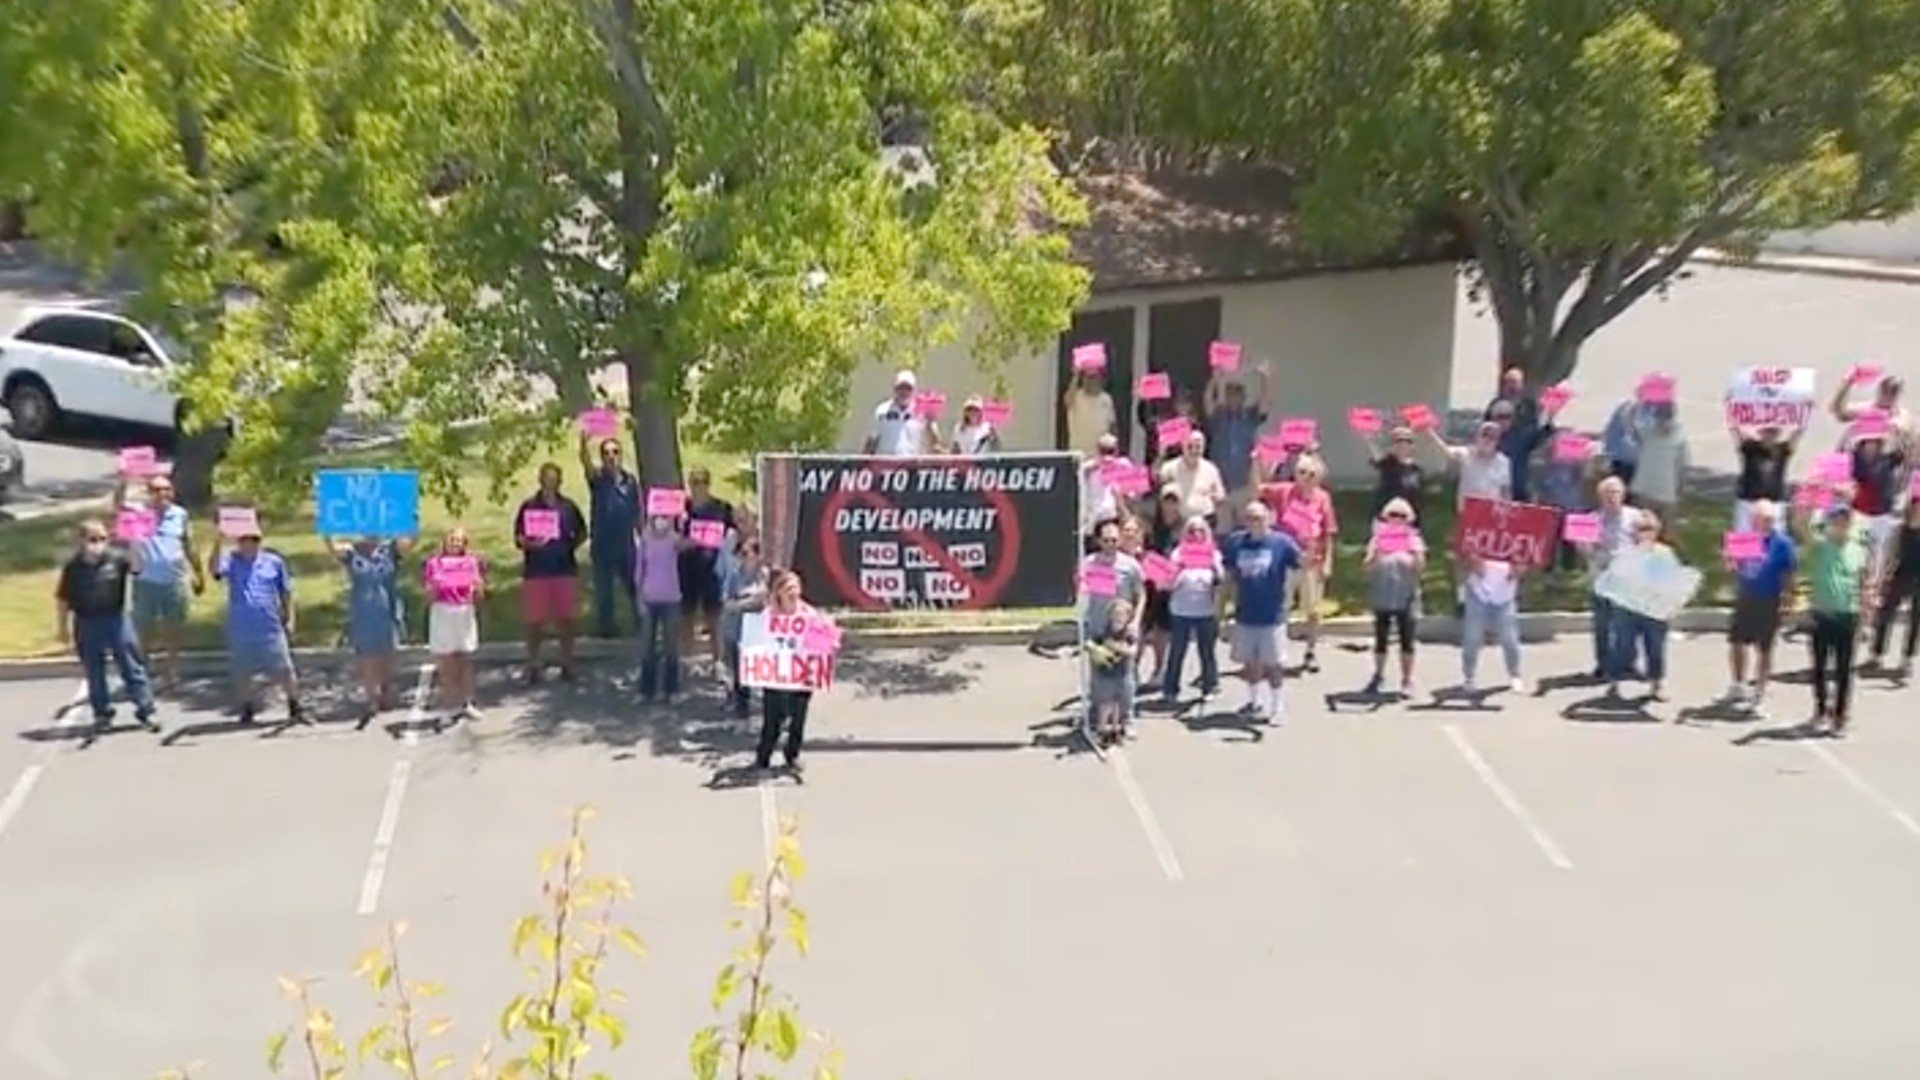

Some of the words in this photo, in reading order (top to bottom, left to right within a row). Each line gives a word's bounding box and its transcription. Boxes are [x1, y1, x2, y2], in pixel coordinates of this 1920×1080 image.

[841, 468, 873, 491] NO
[881, 469, 909, 492] TO
[917, 467, 959, 491] THE
[963, 467, 1055, 491] HOLDEN
[835, 508, 997, 532] DEVELOPMENT
[865, 547, 896, 561] NO
[954, 549, 982, 562] NO
[867, 576, 899, 591] NO
[932, 577, 964, 593] NO
[769, 616, 806, 634] NO
[744, 654, 832, 690] HOLDEN
